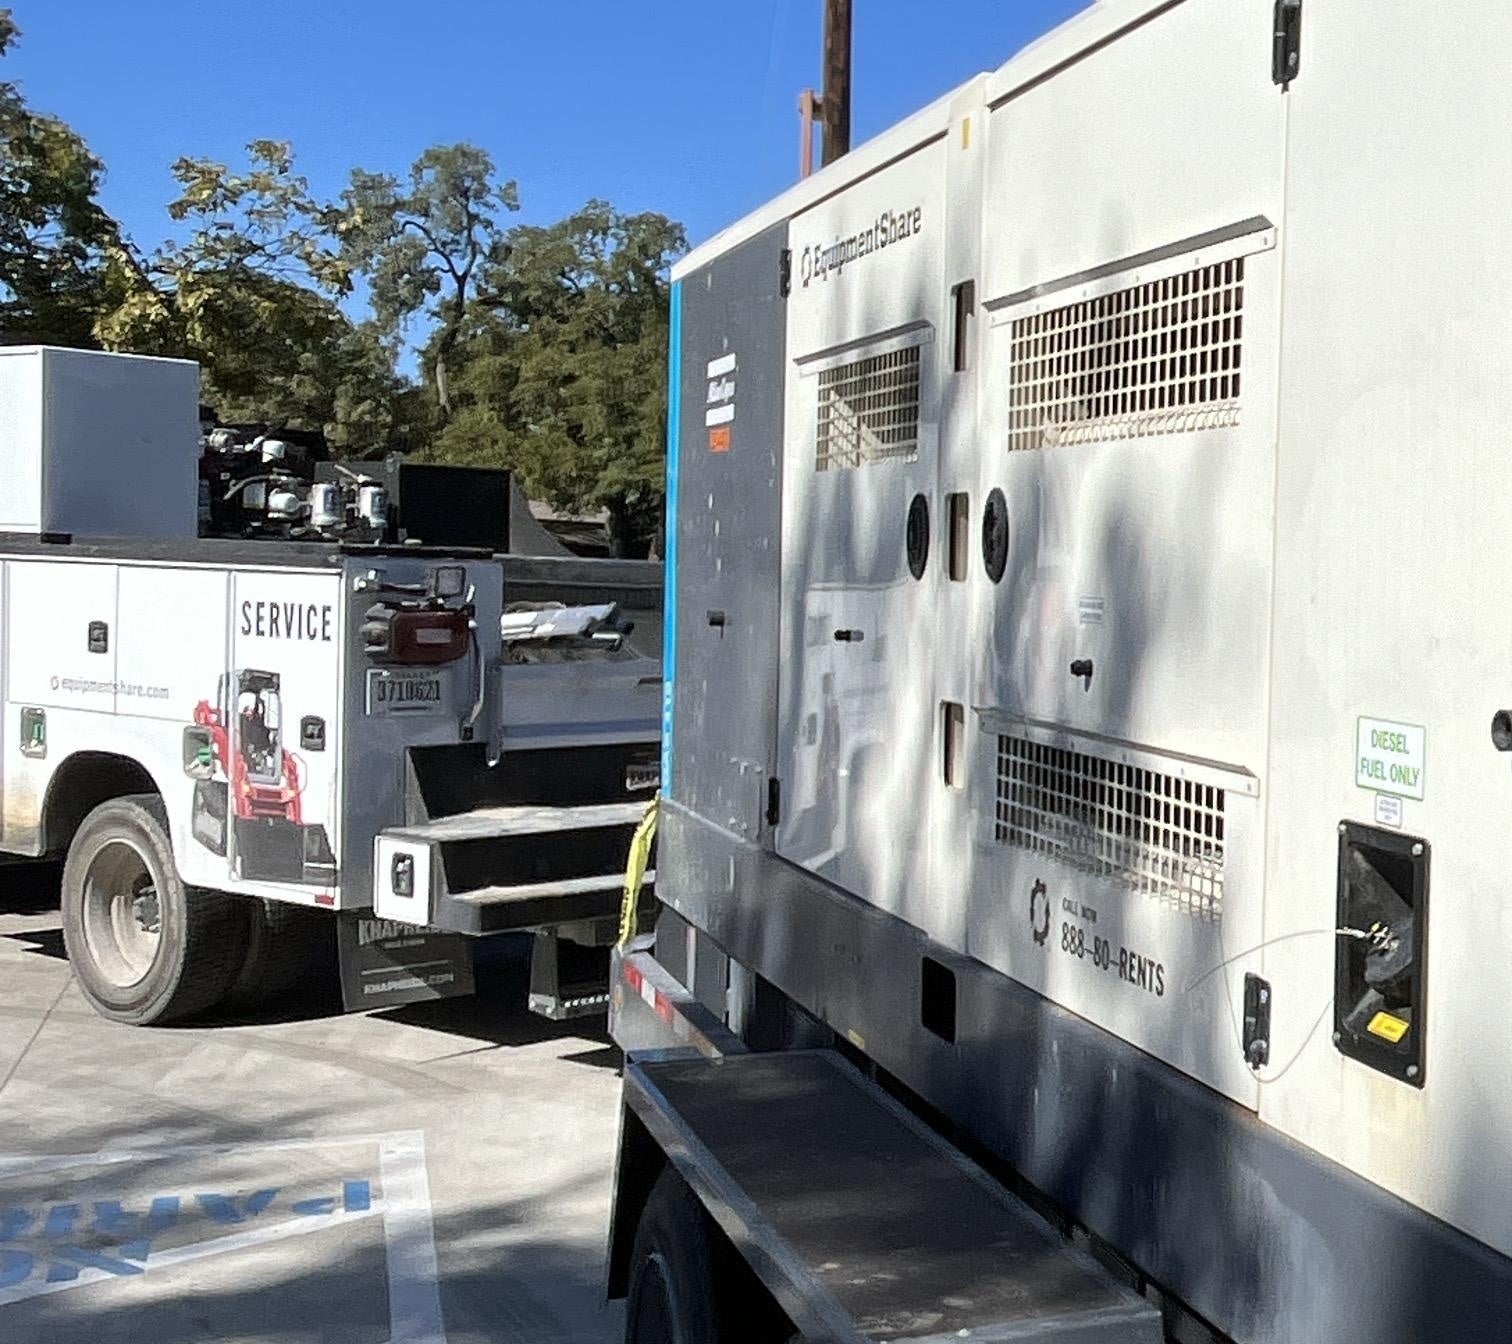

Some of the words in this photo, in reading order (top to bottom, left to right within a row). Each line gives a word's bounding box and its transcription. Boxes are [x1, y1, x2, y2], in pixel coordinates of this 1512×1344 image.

[814, 206, 921, 281] EquipmentShare
[241, 600, 332, 641] SERVICE
[1371, 729, 1410, 755] DIESEL
[1361, 757, 1387, 781] FUEL
[1390, 763, 1421, 787] ONLY
[1062, 921, 1166, 997] 888-80-RENTS
